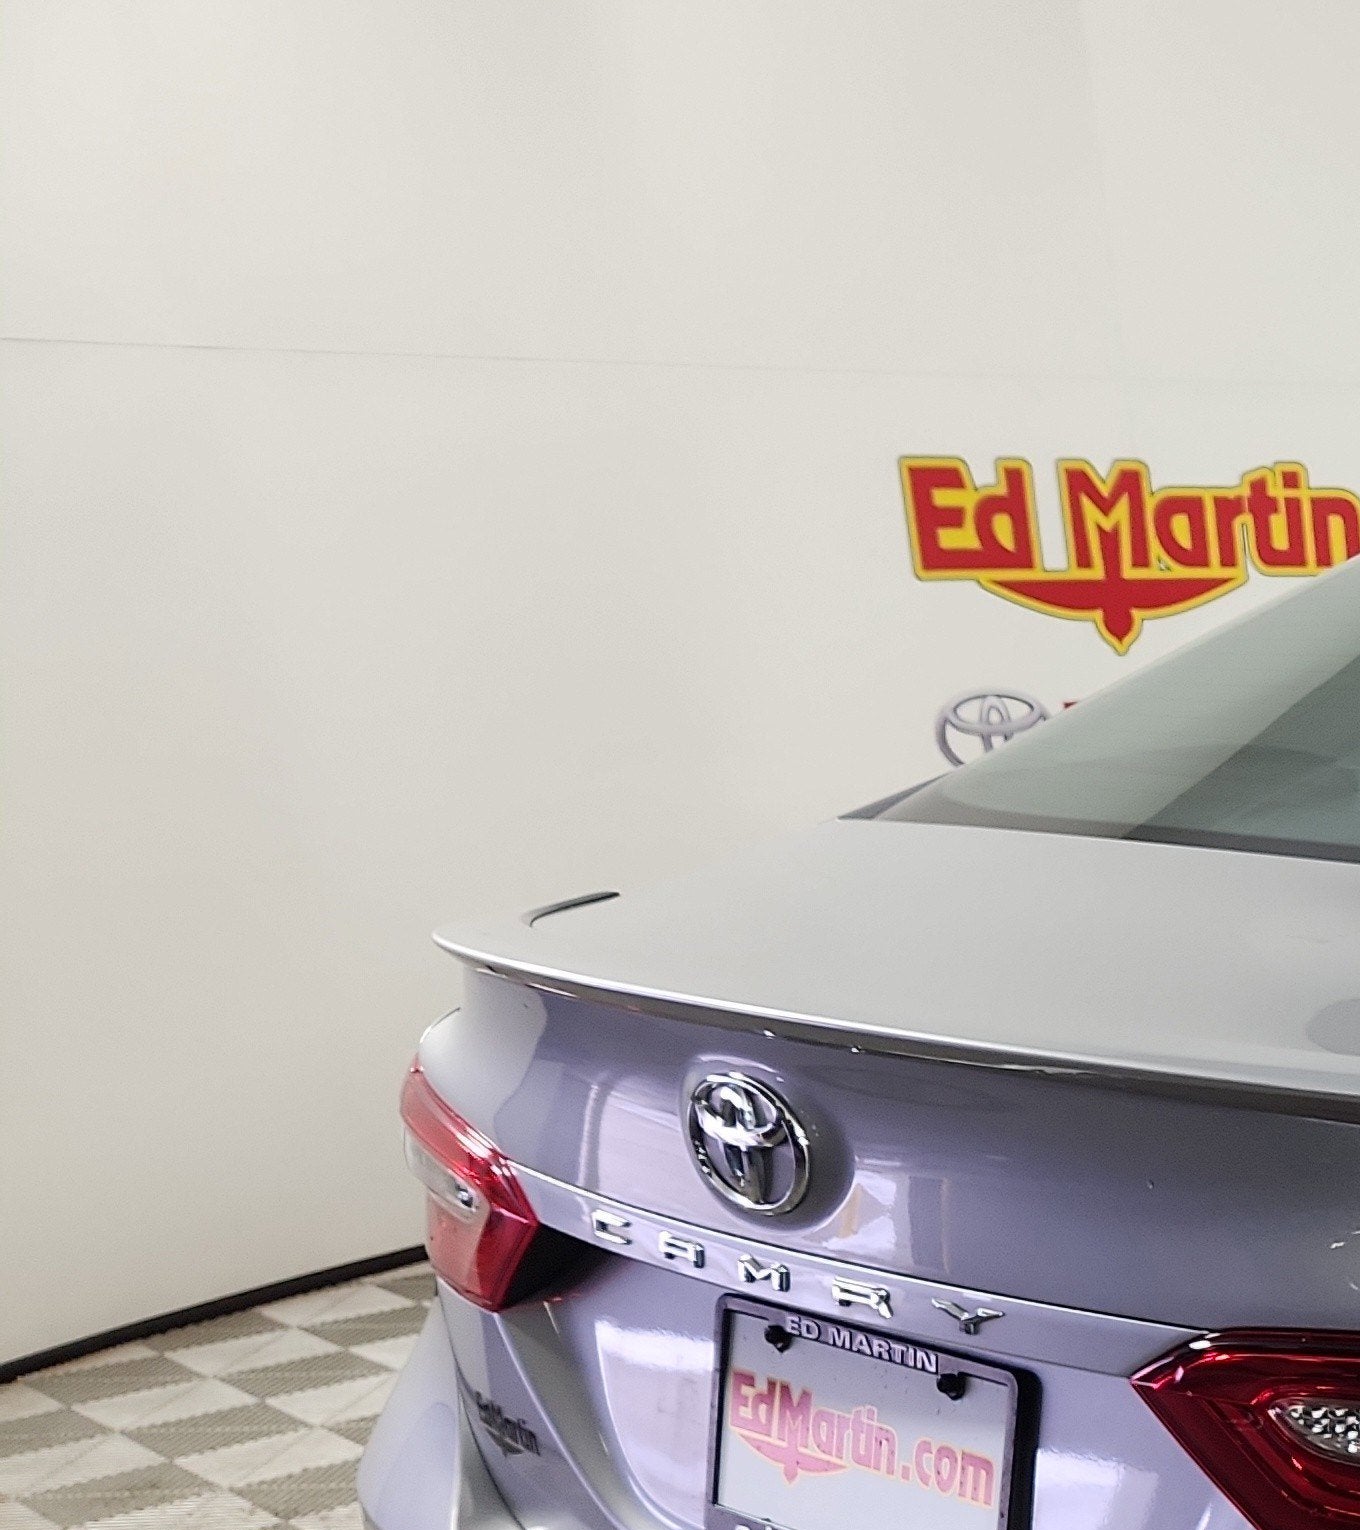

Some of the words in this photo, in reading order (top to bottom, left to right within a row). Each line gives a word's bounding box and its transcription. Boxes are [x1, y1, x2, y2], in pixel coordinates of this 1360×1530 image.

[899, 457, 1043, 580] Ed
[591, 1209, 1004, 1335] CAMRY
[785, 1315, 820, 1340] ED
[827, 1326, 940, 1374] MARTIN
